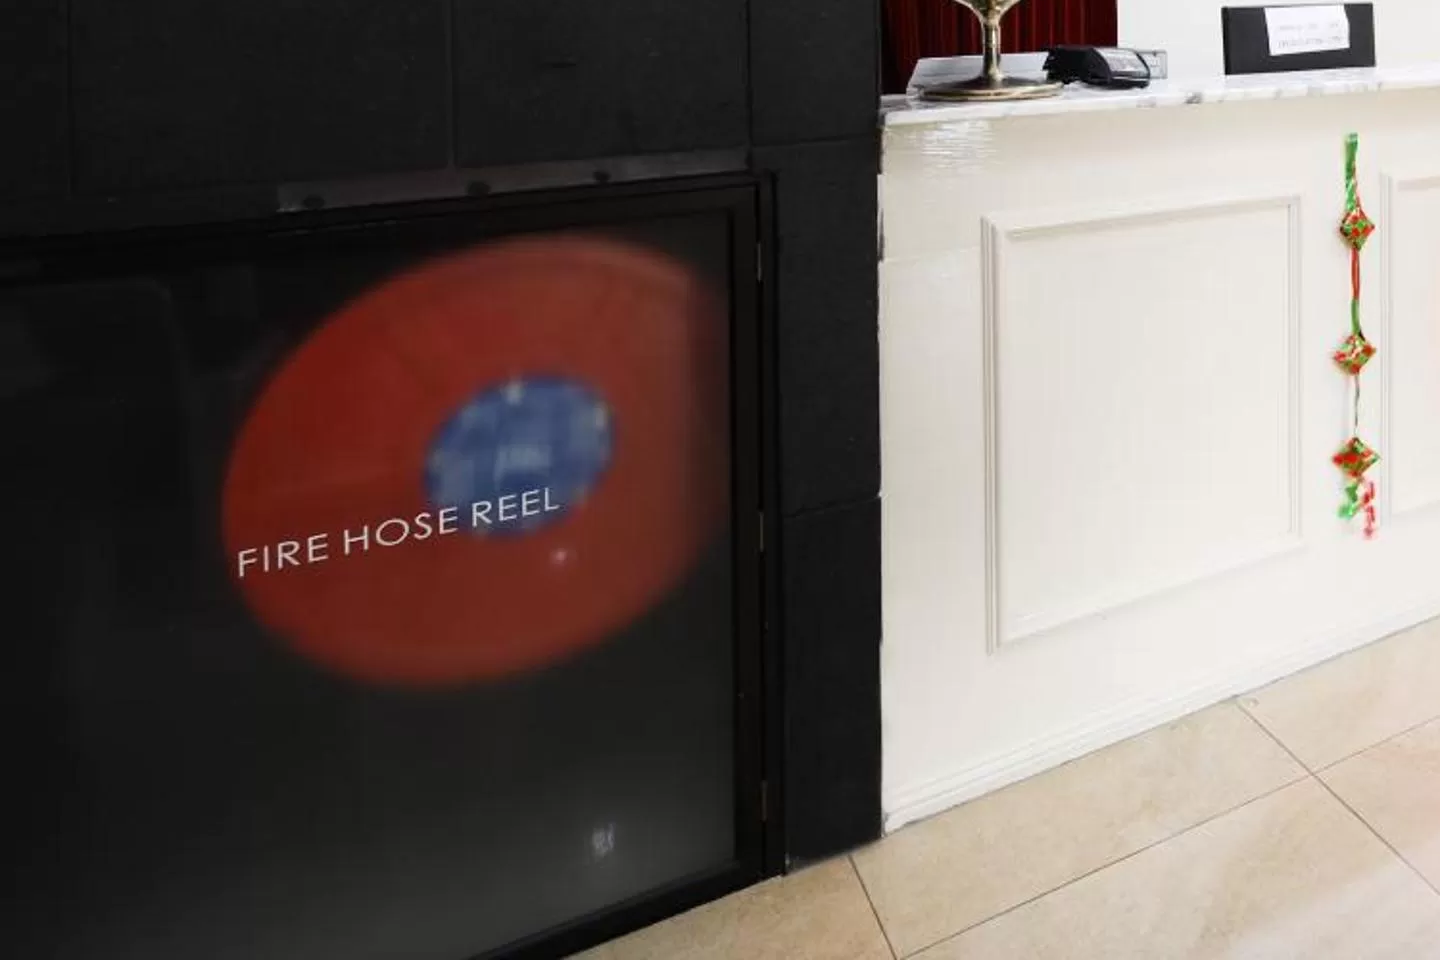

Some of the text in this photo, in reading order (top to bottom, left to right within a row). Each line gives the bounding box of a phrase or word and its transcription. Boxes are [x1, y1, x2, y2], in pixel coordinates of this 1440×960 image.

[237, 487, 561, 578] FIRE HOSE REEL
